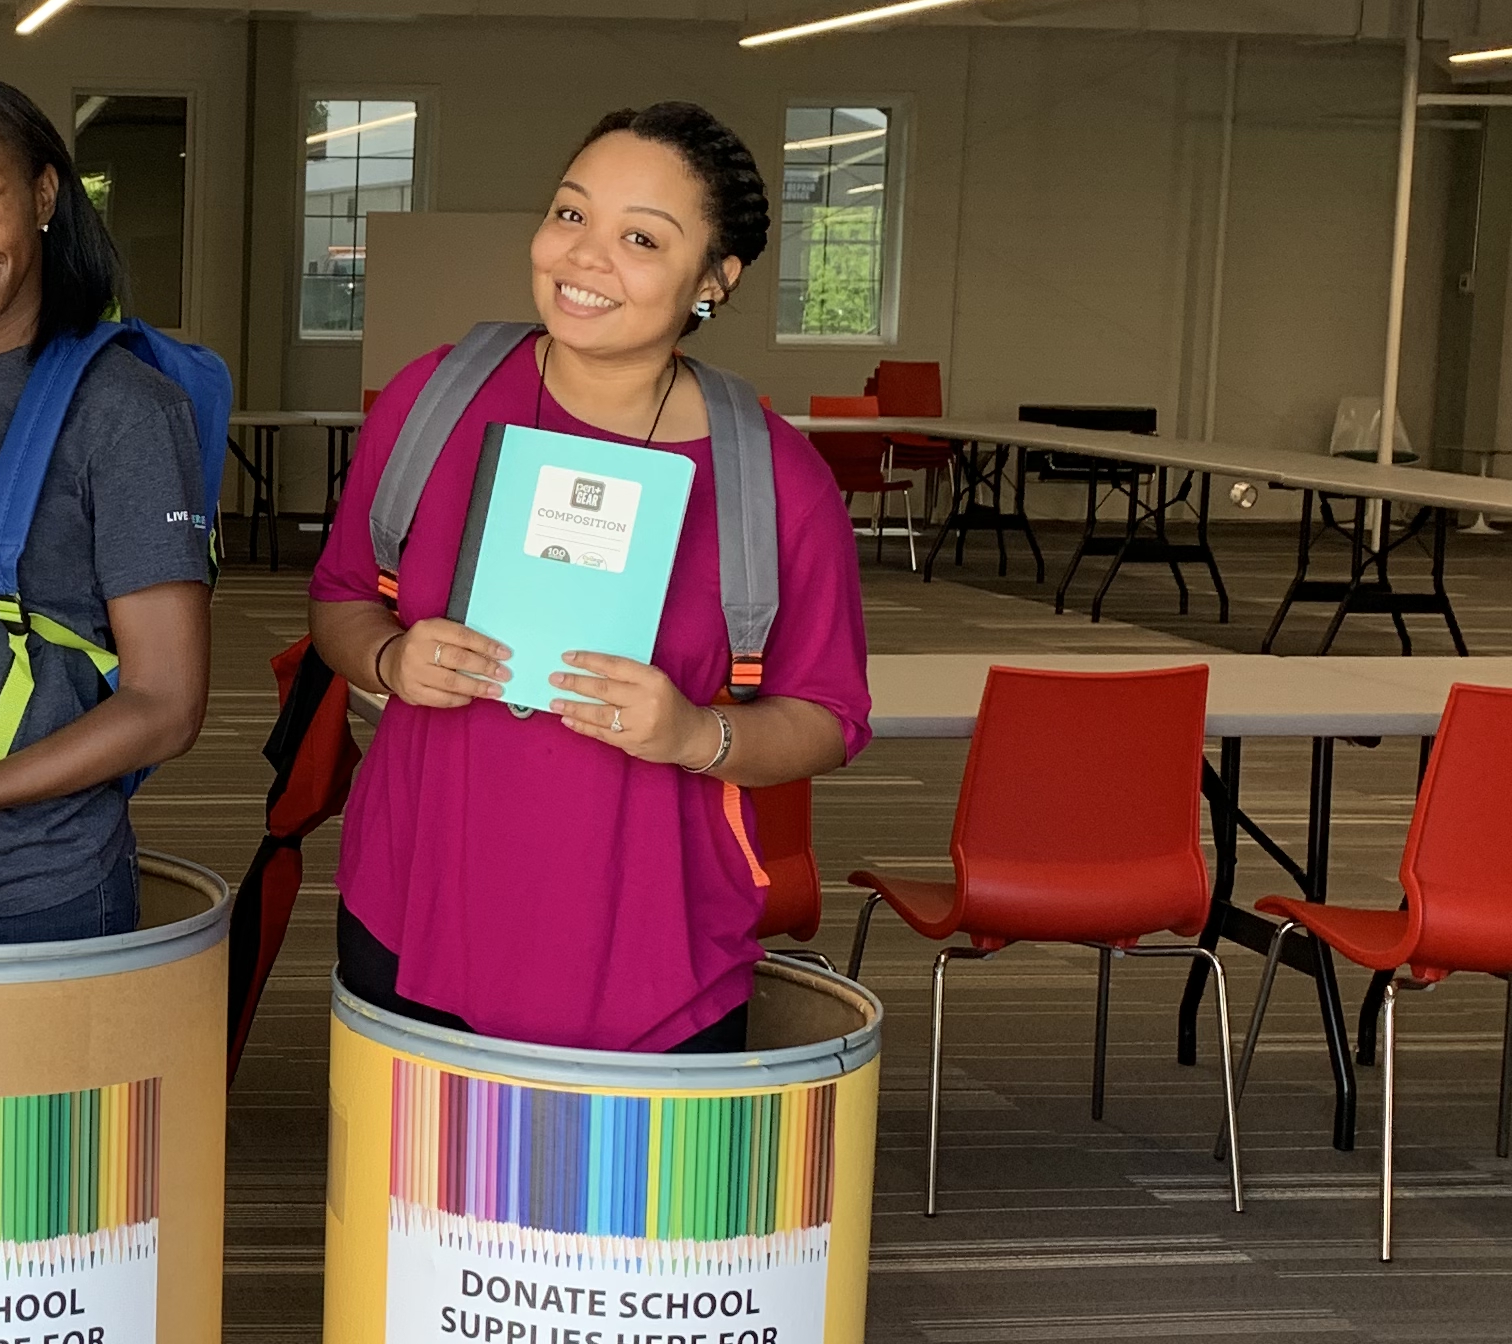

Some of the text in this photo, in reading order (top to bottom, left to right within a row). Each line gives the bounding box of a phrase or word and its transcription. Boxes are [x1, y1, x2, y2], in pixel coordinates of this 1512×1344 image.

[575, 491, 600, 507] GEAR
[537, 507, 627, 533] COMPOSITION
[547, 547, 566, 558] 100
[462, 1269, 760, 1320] DONATE SCHOOL
